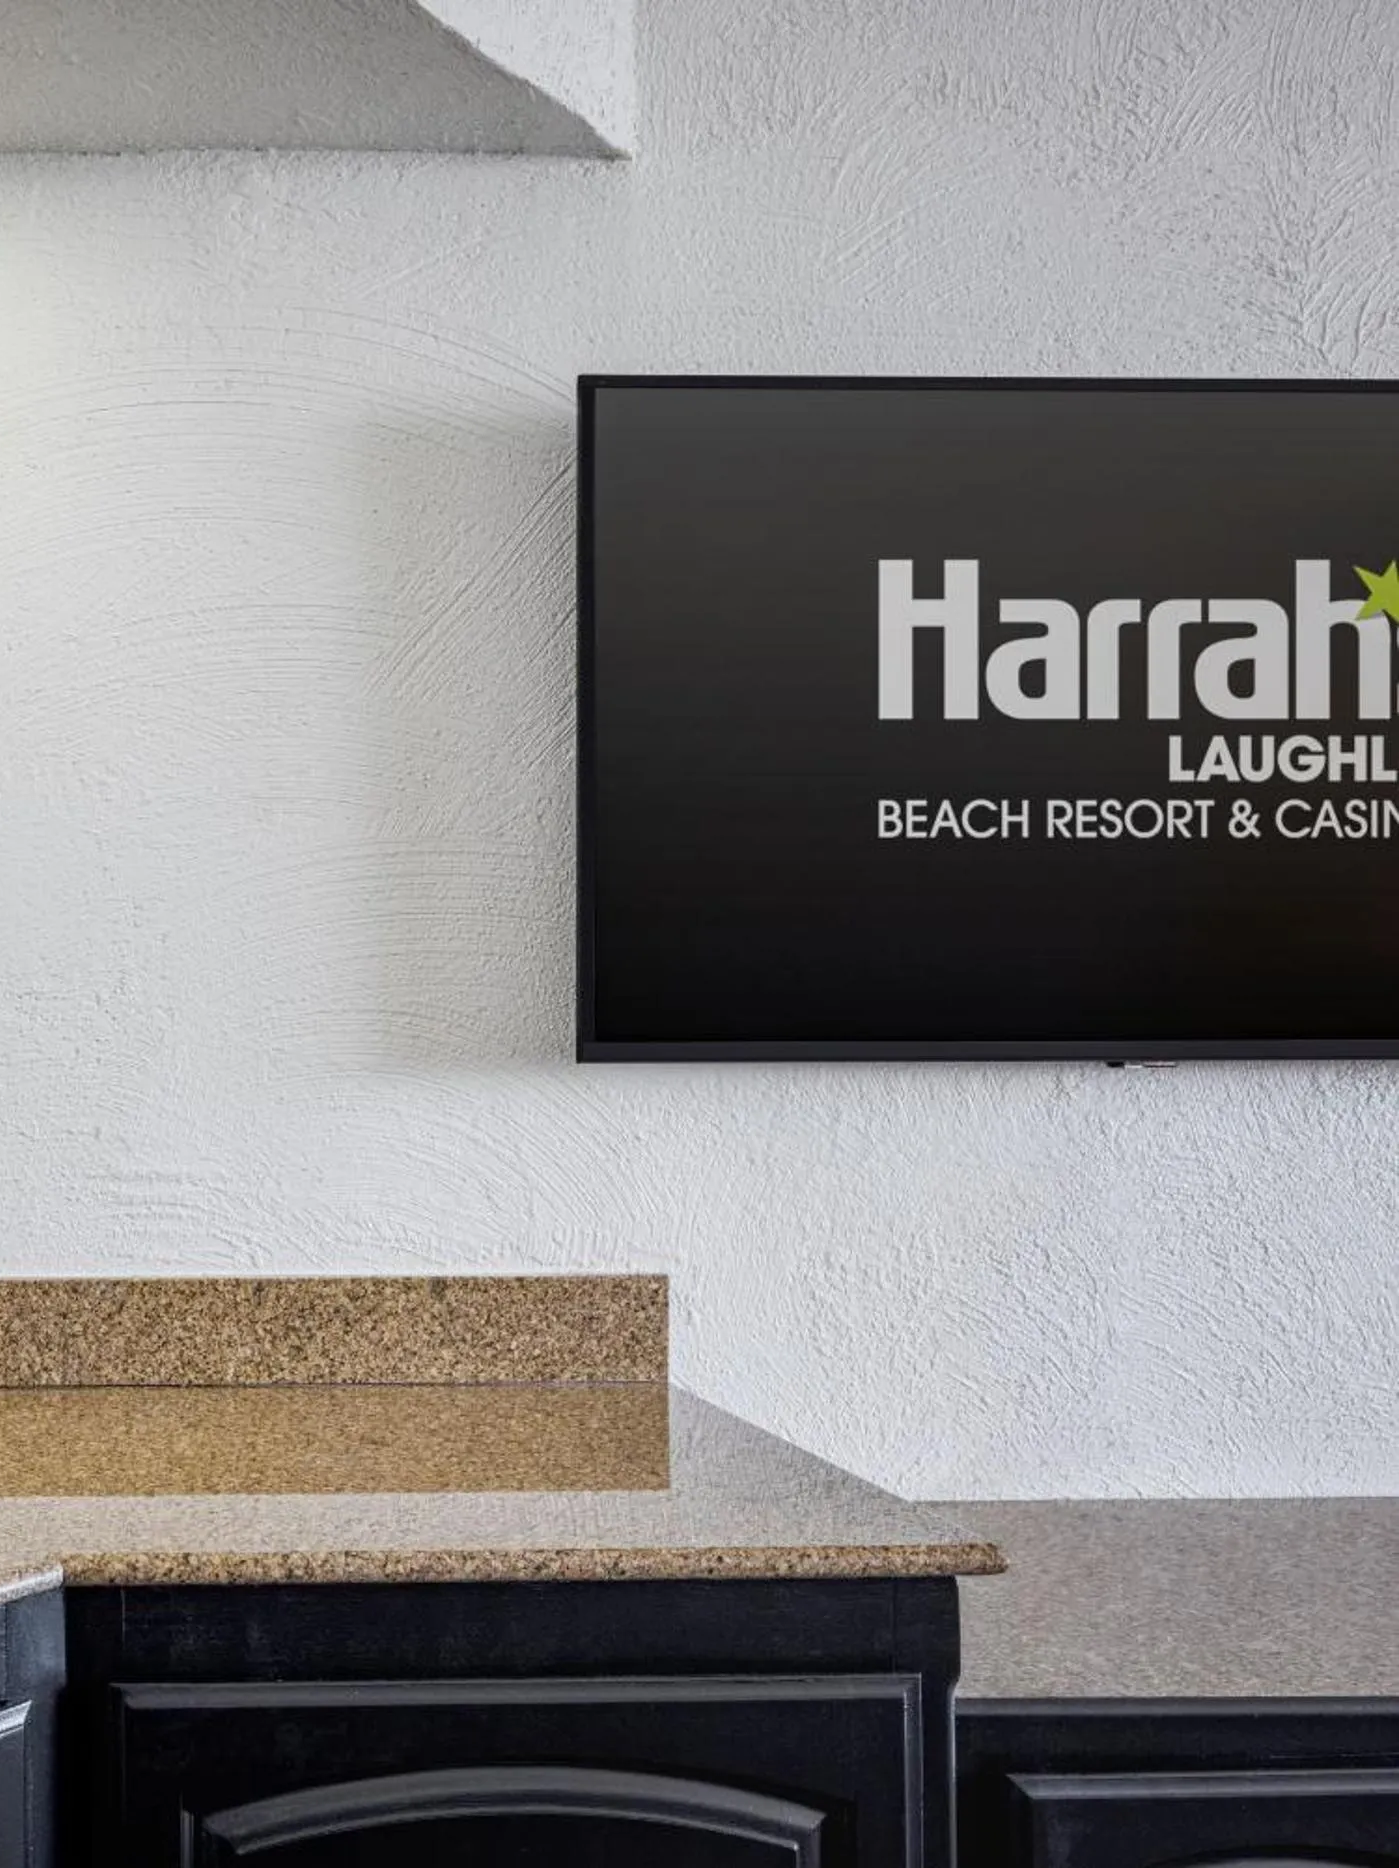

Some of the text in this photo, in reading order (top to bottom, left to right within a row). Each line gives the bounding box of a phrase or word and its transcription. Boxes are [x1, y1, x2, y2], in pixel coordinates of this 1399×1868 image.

[878, 559, 1399, 720] Harrah
[1168, 735, 1398, 783] LAUGHL
[878, 799, 1029, 839] BEACH
[1047, 799, 1215, 839] RESORT
[1228, 799, 1261, 839] &
